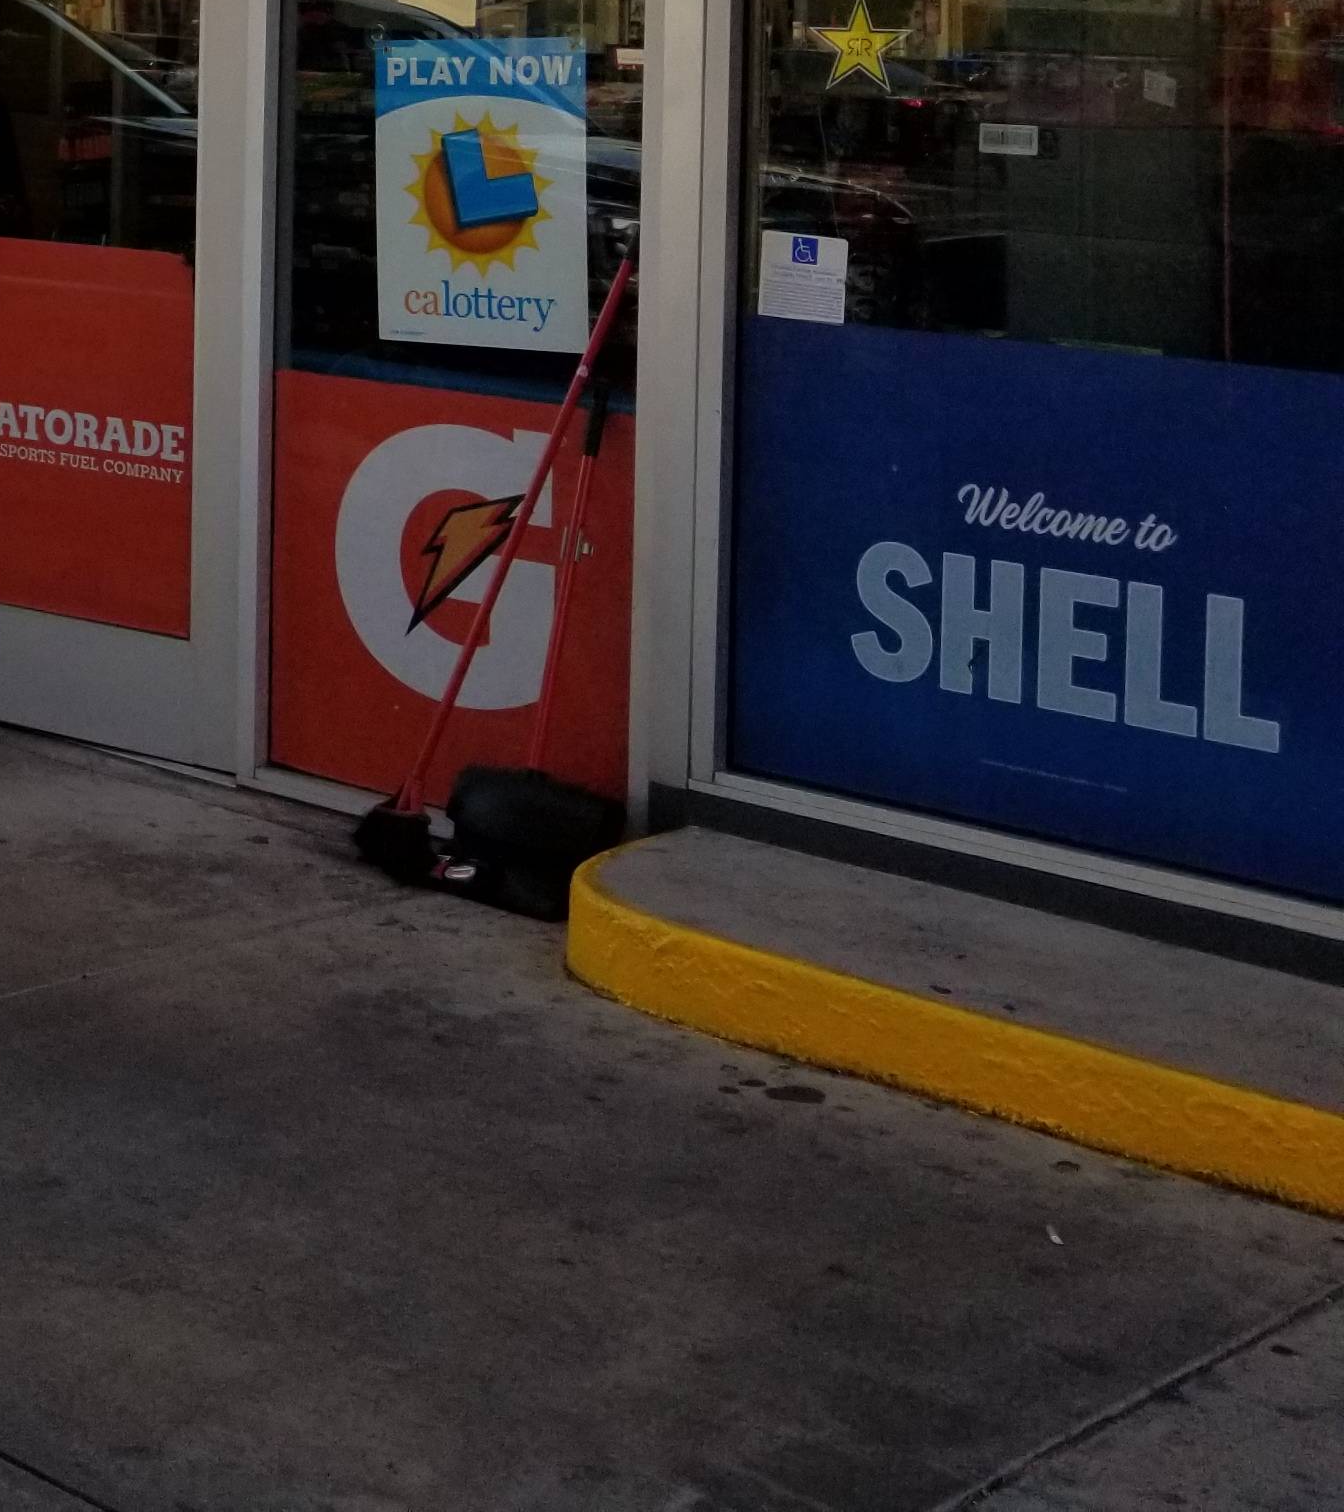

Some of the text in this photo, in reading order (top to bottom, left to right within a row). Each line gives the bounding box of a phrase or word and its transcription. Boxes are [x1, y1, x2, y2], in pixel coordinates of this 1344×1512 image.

[386, 54, 574, 86] PLAY NOW
[404, 279, 555, 332] calottery
[0, 443, 56, 465] SPORTS
[60, 452, 99, 472] FUEL
[103, 458, 185, 484] COMPANY
[957, 483, 1179, 553] Welcome to
[851, 540, 1281, 754] SHELL
